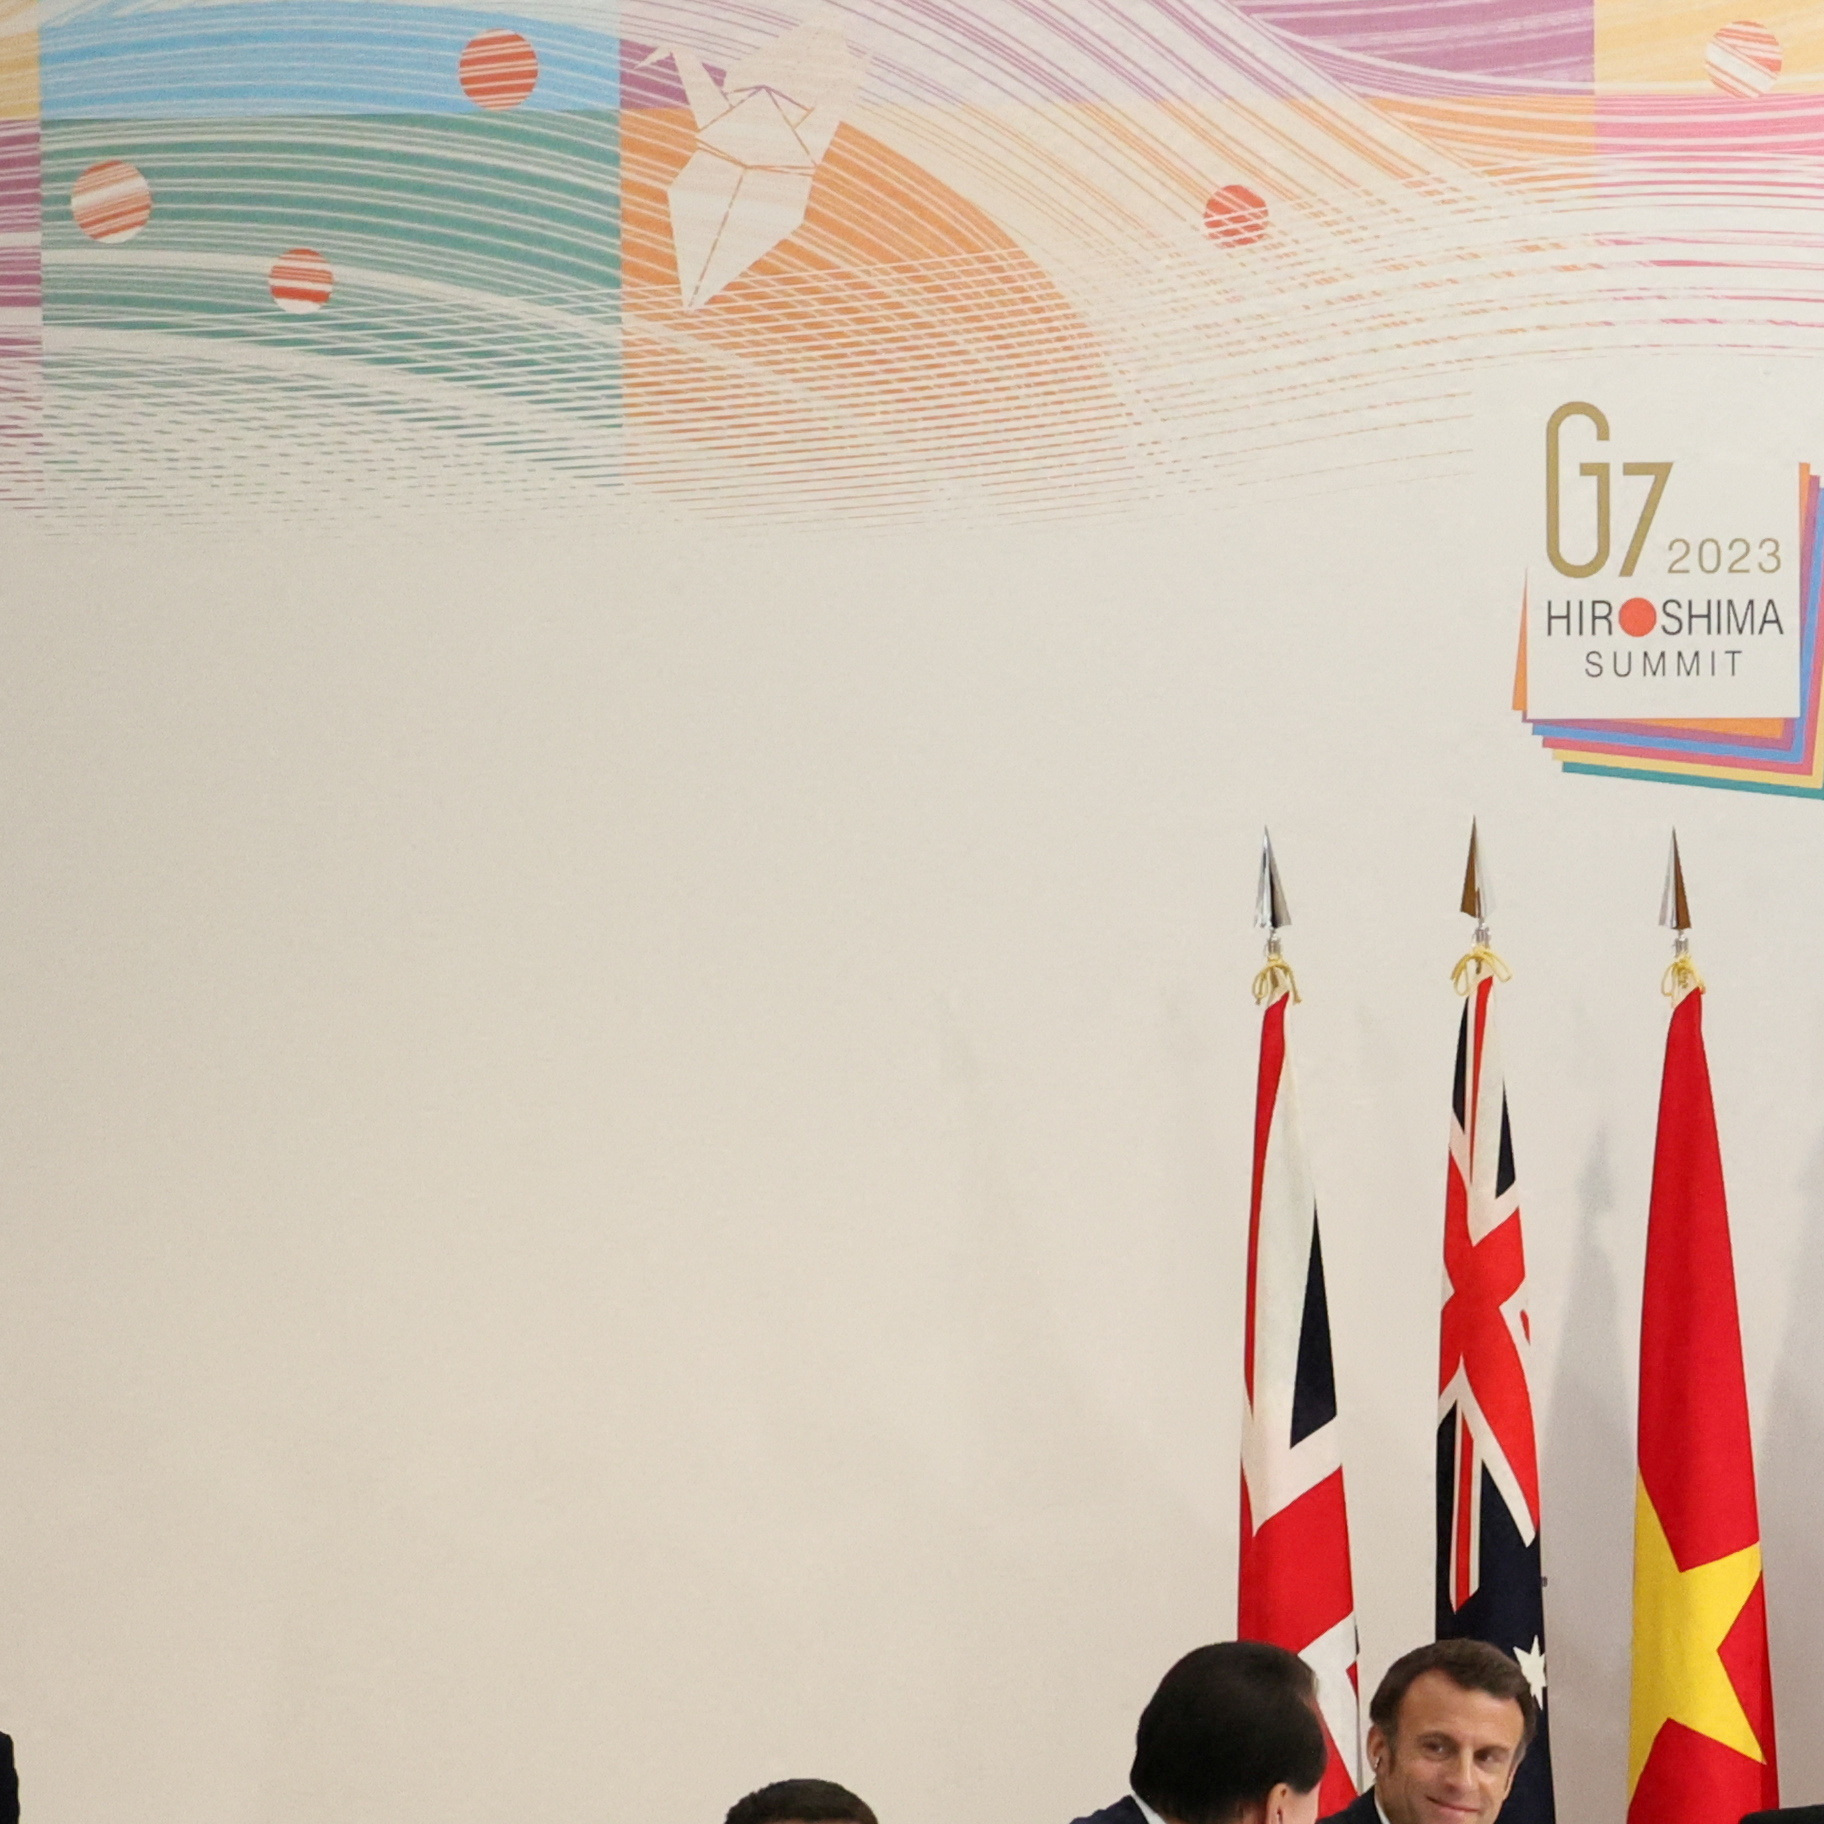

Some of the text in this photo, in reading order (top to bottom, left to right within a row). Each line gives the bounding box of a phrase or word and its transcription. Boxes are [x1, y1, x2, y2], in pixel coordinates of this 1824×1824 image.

[1546, 400, 1783, 579] G7 2023
[1584, 650, 1744, 678] SUMMIT
